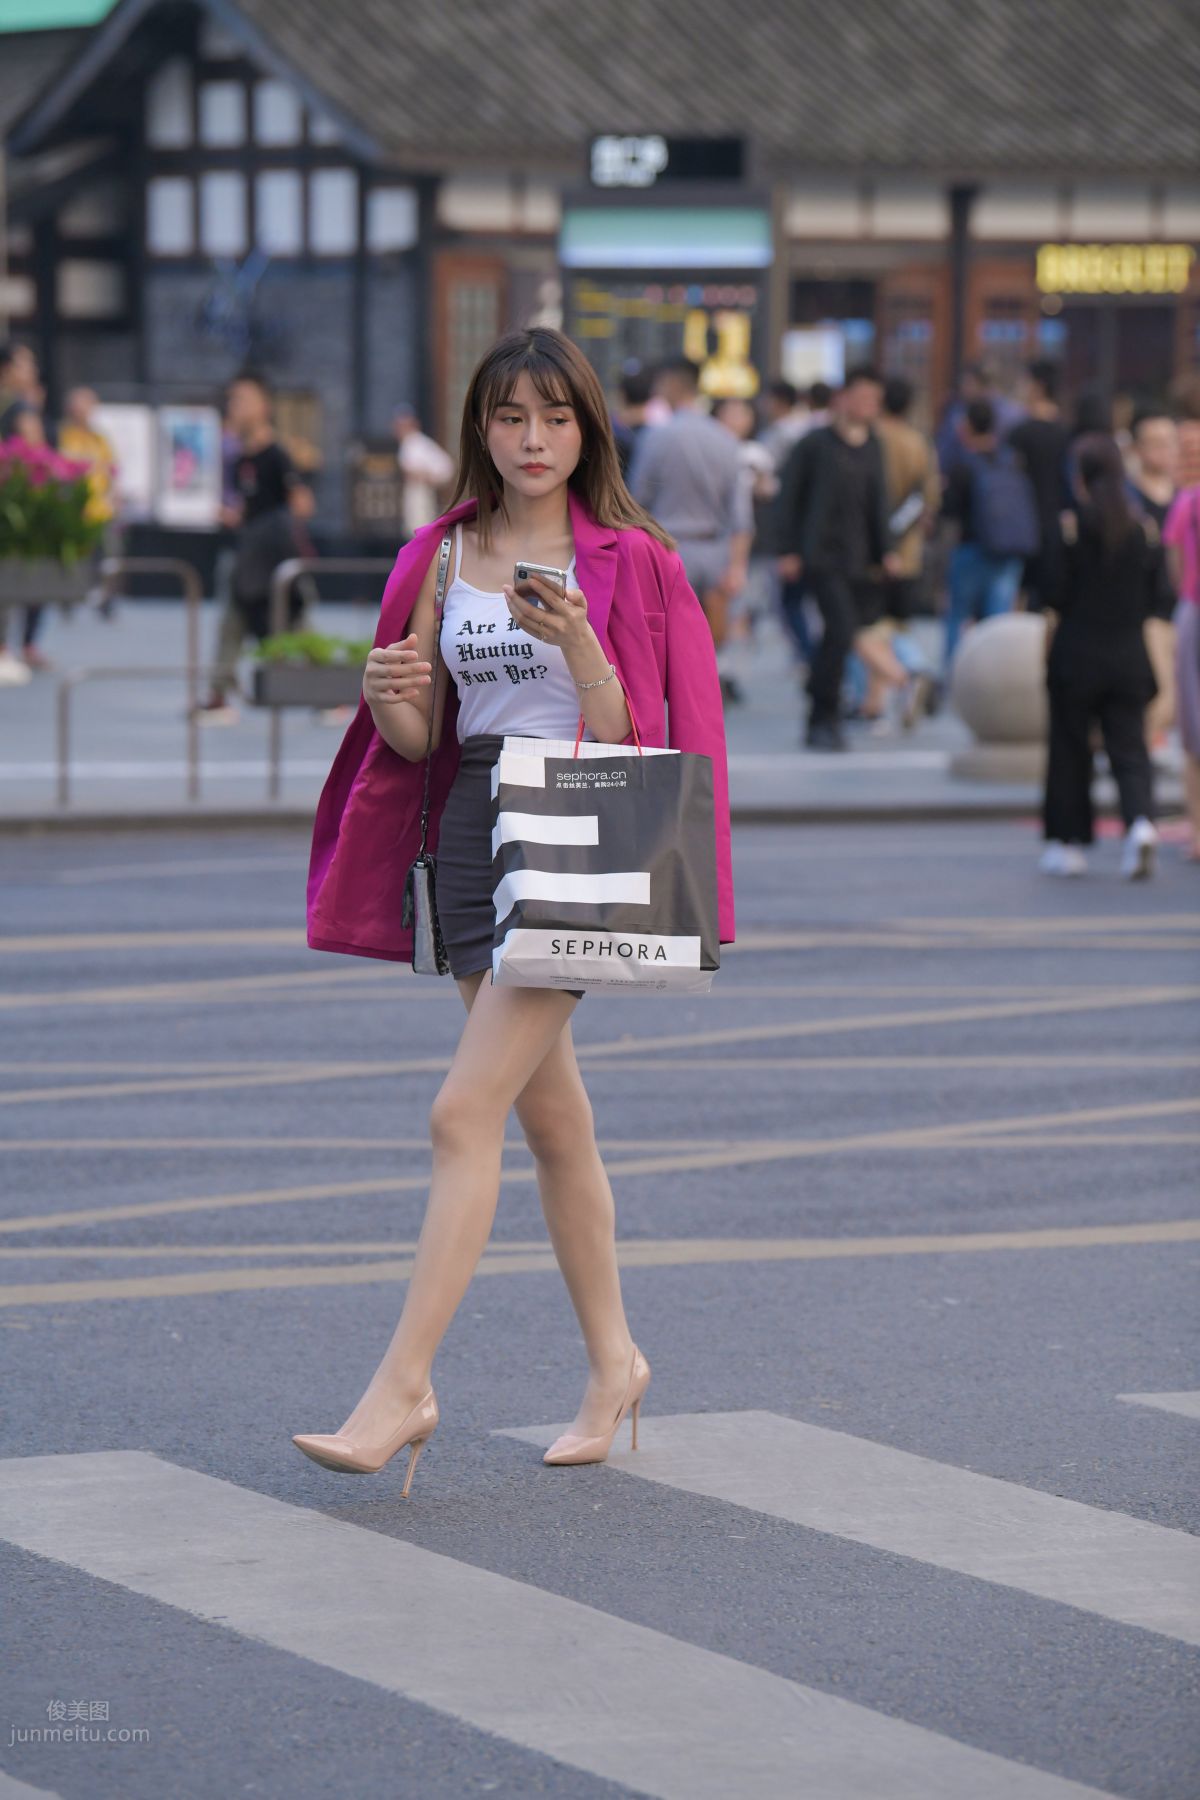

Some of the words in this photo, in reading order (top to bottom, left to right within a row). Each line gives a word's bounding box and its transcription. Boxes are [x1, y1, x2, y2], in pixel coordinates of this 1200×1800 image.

[456, 620, 496, 636] Are
[457, 669, 498, 687] Fun
[503, 664, 548, 684] Yet?
[556, 771, 627, 783] sephora.cn
[551, 939, 667, 961] SEPHORA
